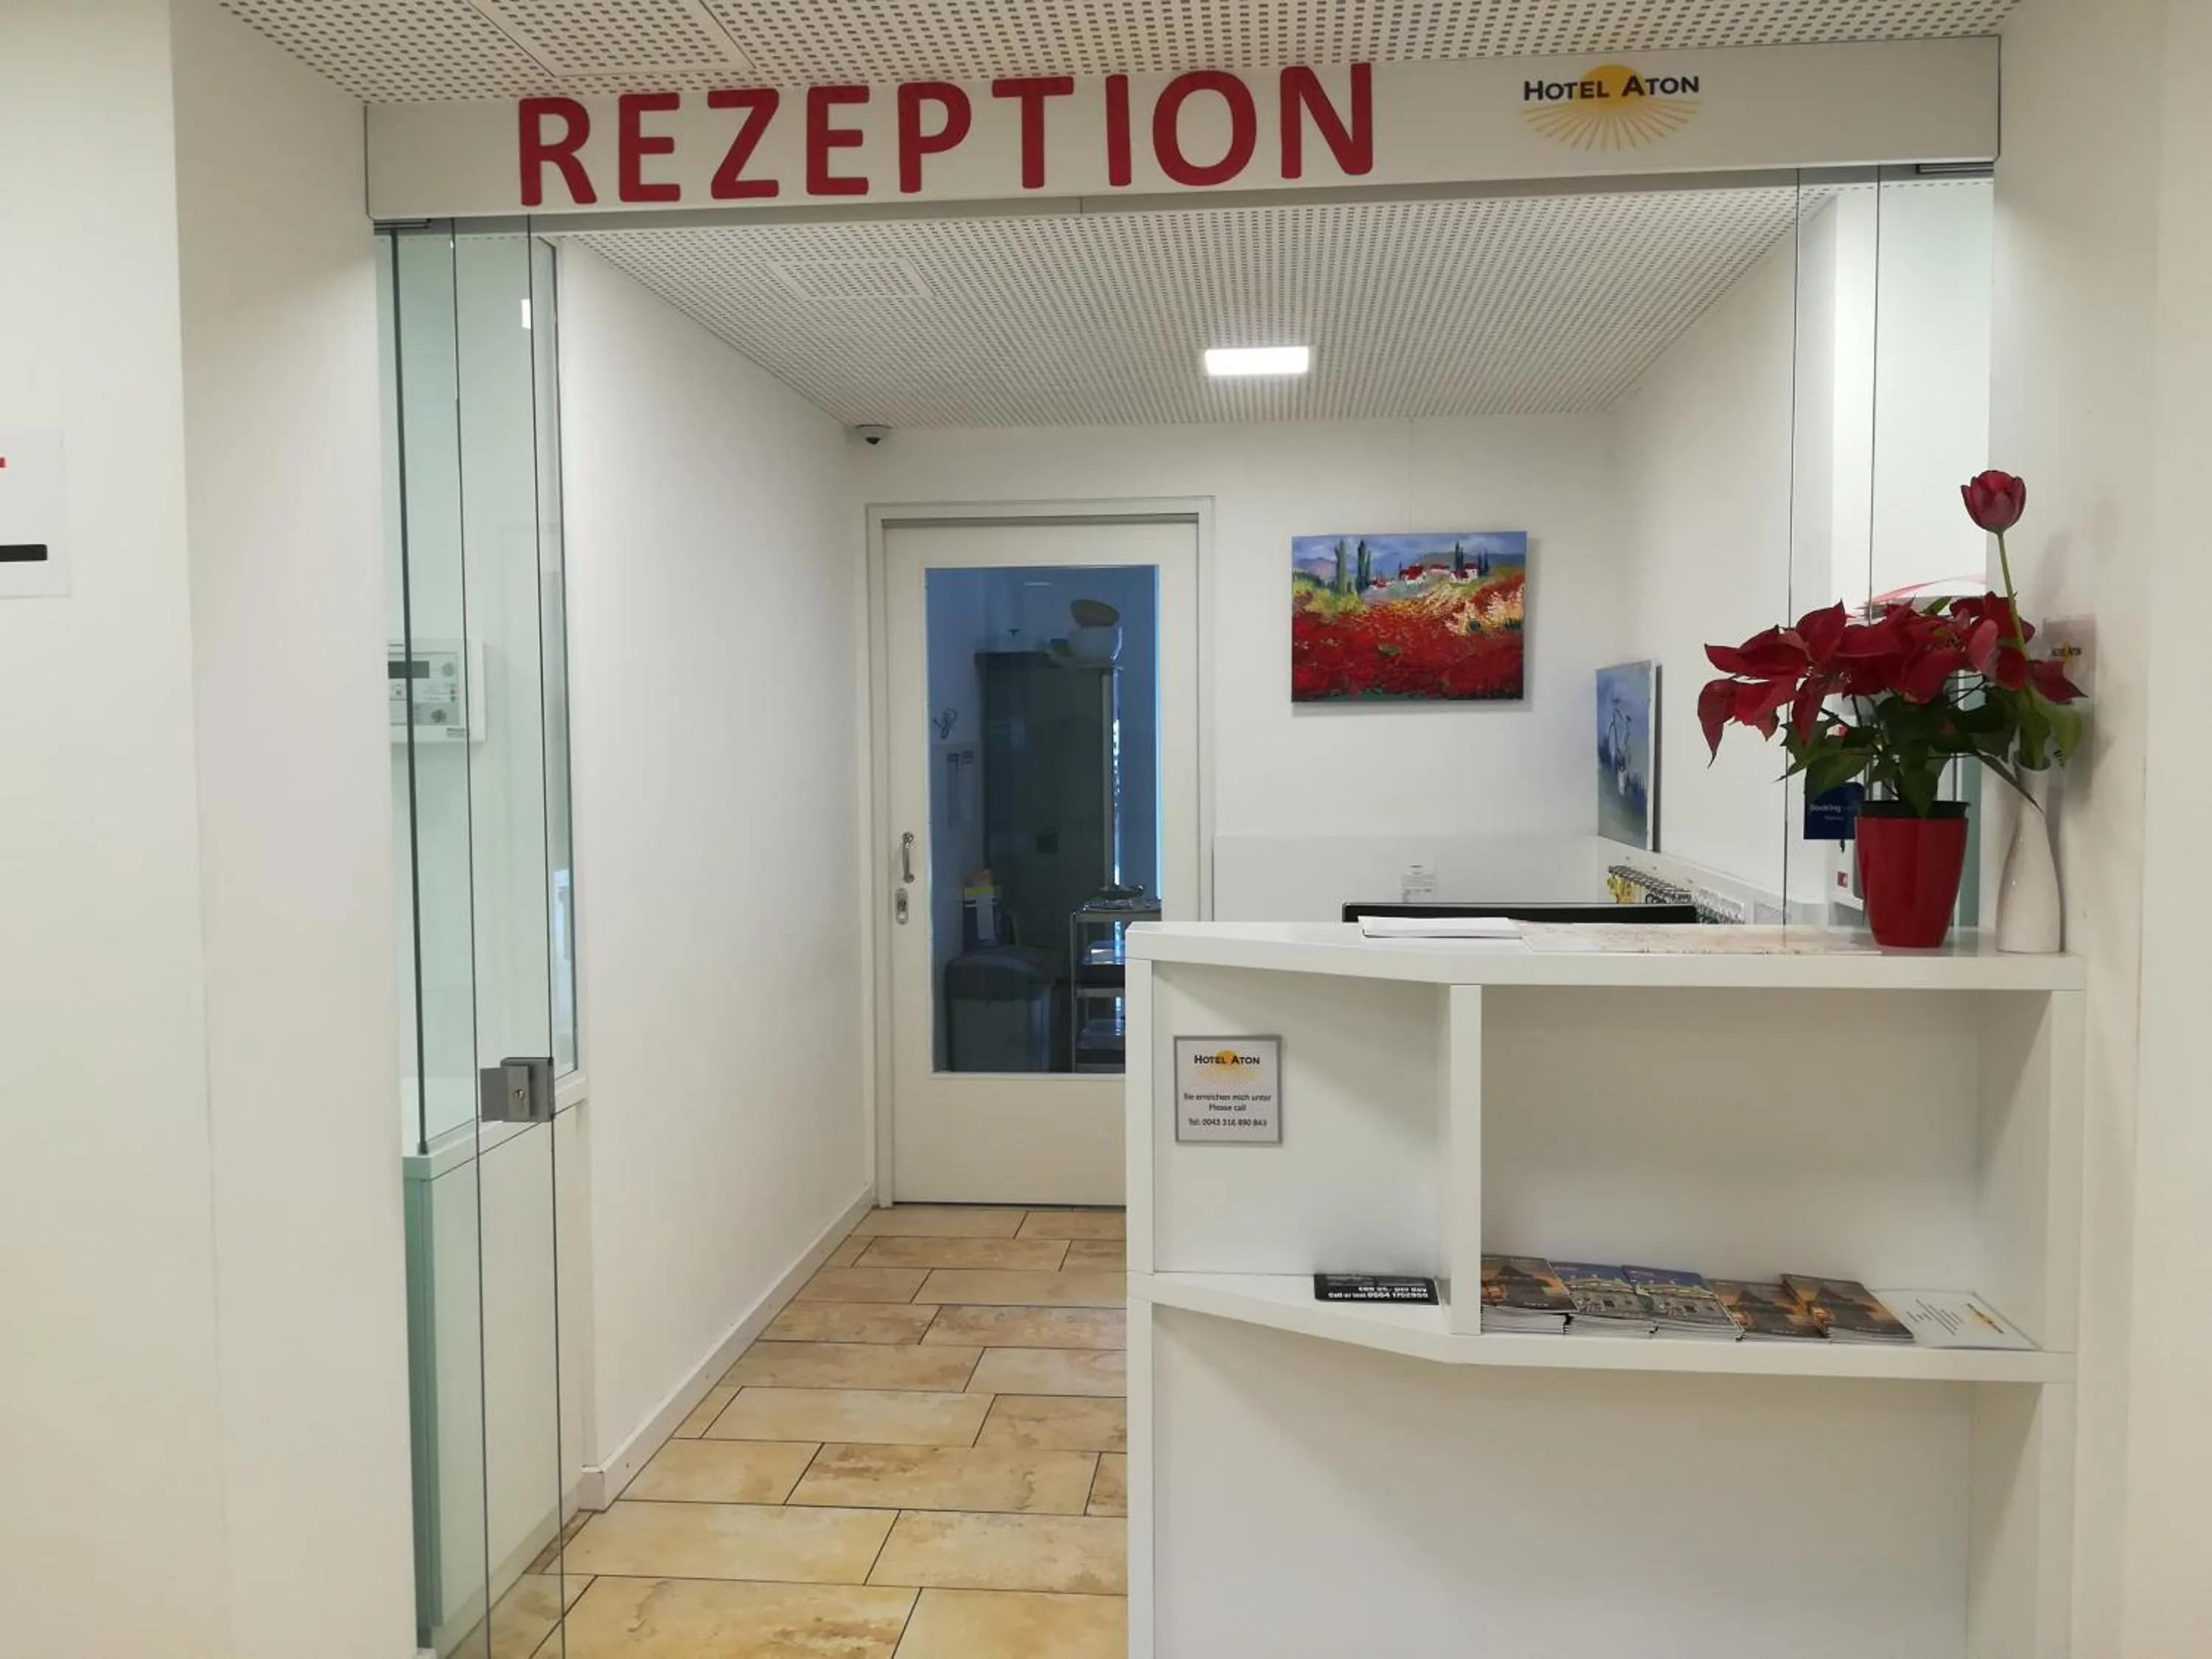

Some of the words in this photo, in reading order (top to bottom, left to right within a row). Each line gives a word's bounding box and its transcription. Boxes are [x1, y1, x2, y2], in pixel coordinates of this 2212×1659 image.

[1524, 80, 1610, 101] HOTEL
[1621, 75, 1700, 97] ATON
[520, 64, 1372, 205] REZEPTION
[1194, 1055, 1227, 1064] HOTEL
[1231, 1055, 1260, 1065] ATON
[1209, 1103, 1232, 1111] Please
